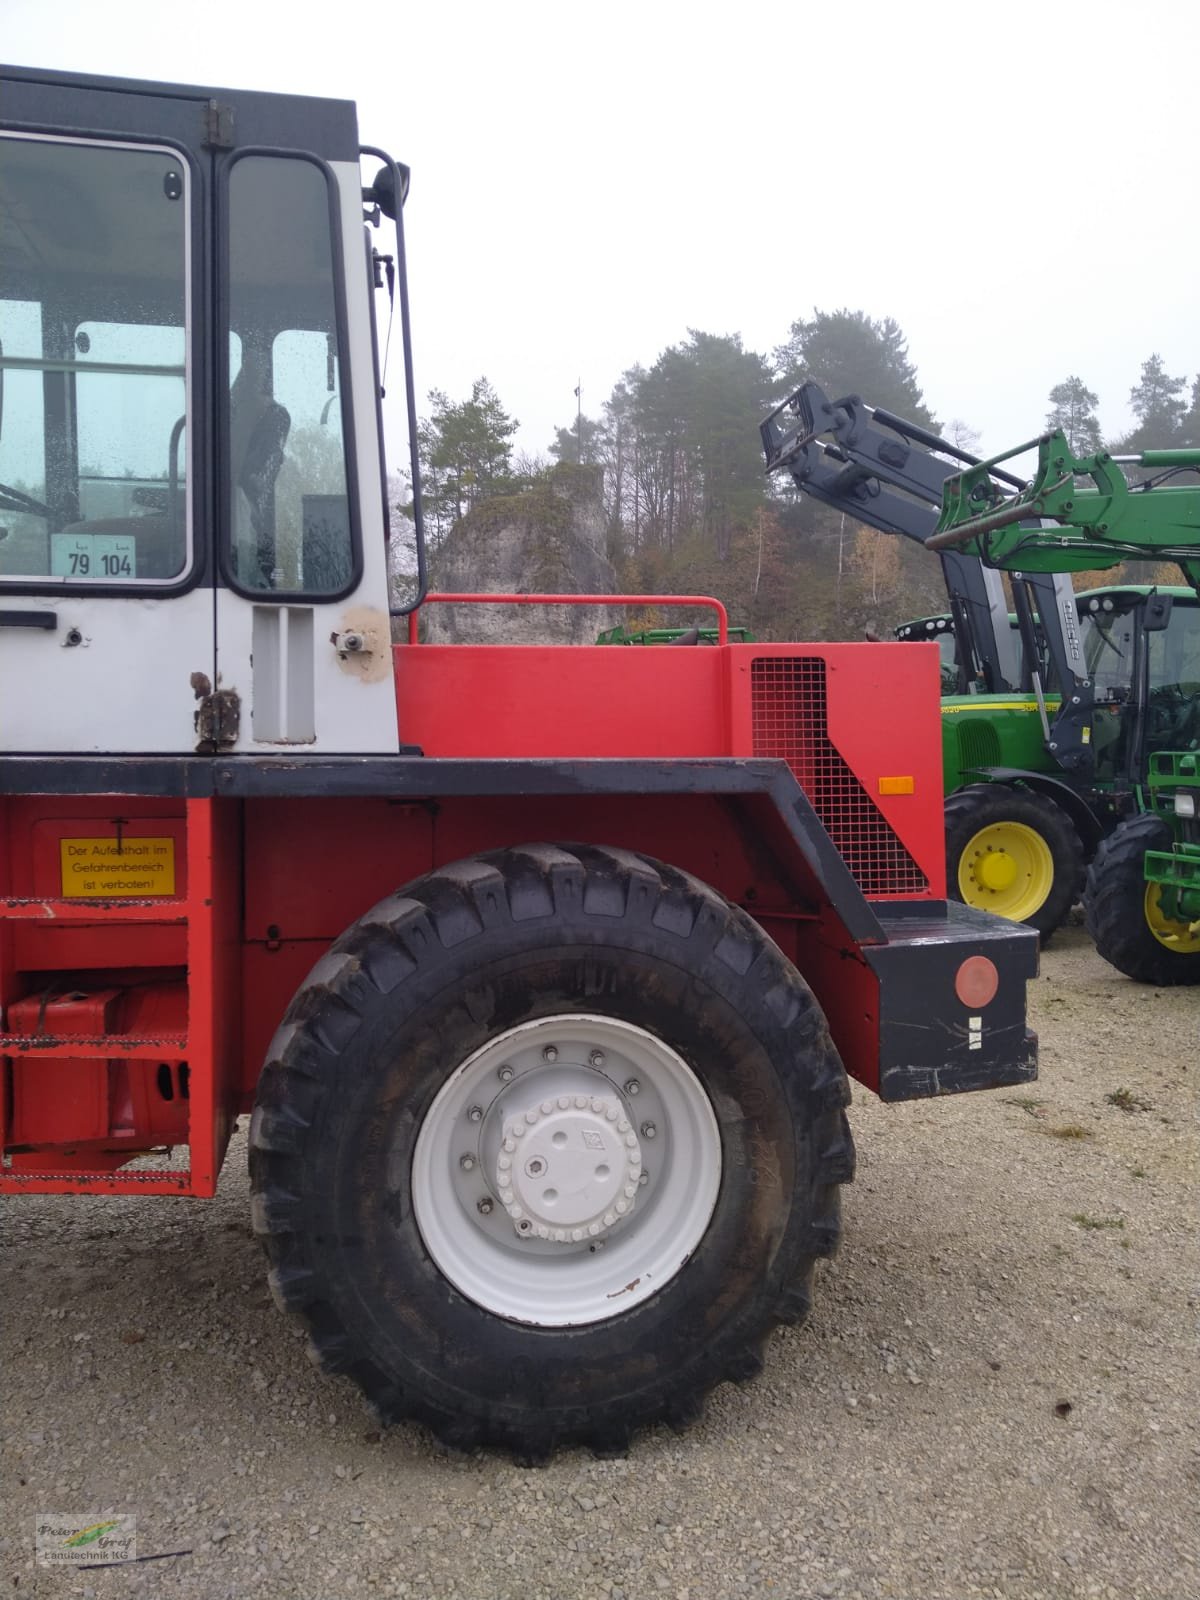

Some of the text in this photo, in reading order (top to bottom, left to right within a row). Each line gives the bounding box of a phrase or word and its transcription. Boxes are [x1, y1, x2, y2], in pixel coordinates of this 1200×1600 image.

[69, 553, 89, 575] 79
[101, 554, 131, 576] 104
[68, 845, 87, 856] Der
[153, 844, 167, 855] im
[72, 862, 164, 873] Gefahrenbereich
[83, 879, 154, 890] ist verboten!
